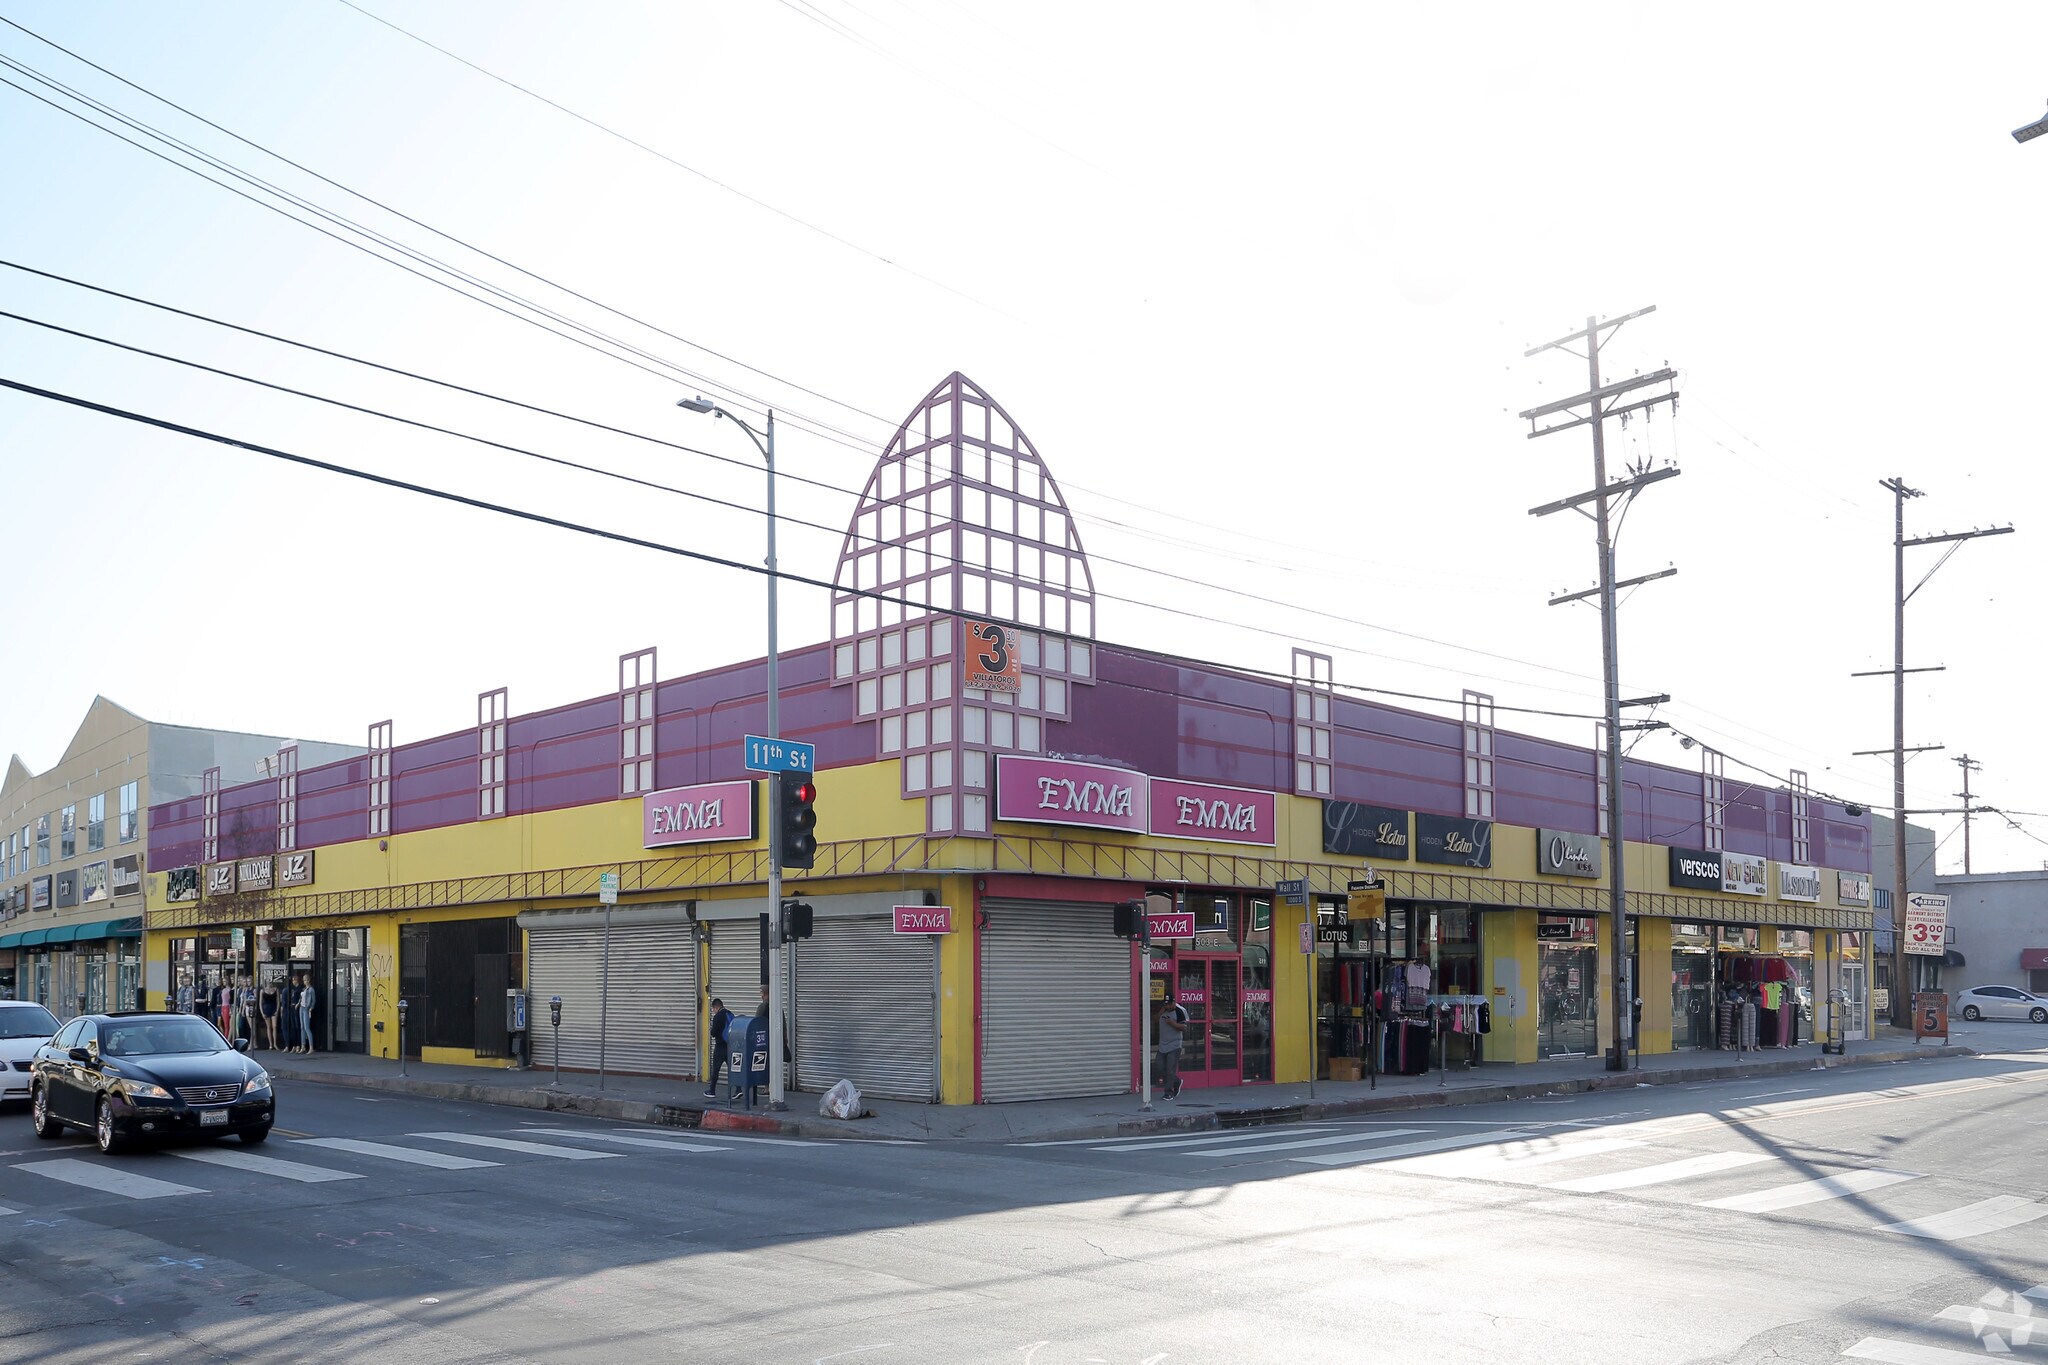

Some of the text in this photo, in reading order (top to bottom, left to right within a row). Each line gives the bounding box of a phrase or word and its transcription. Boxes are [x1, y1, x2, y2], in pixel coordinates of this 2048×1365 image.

[973, 672, 1015, 684] VILLATOROS
[753, 743, 806, 768] 11th St
[1038, 777, 1132, 817] EMMA
[652, 799, 724, 834] EMMA
[1177, 796, 1256, 832] EMMA
[1352, 822, 1406, 846] HIDDEN Lotus
[1421, 832, 1473, 854] HIDDEN Lotus
[210, 867, 229, 890] JZ
[283, 856, 304, 881] JZ
[1680, 858, 1720, 878] verscos
[1279, 882, 1300, 892] Wall St
[902, 914, 946, 928] EMMA
[1321, 931, 1348, 941] LOTUS
[1181, 993, 1203, 1001] EMMA
[1246, 993, 1267, 1001] EMMA
[1924, 1009, 1939, 1032] 5
